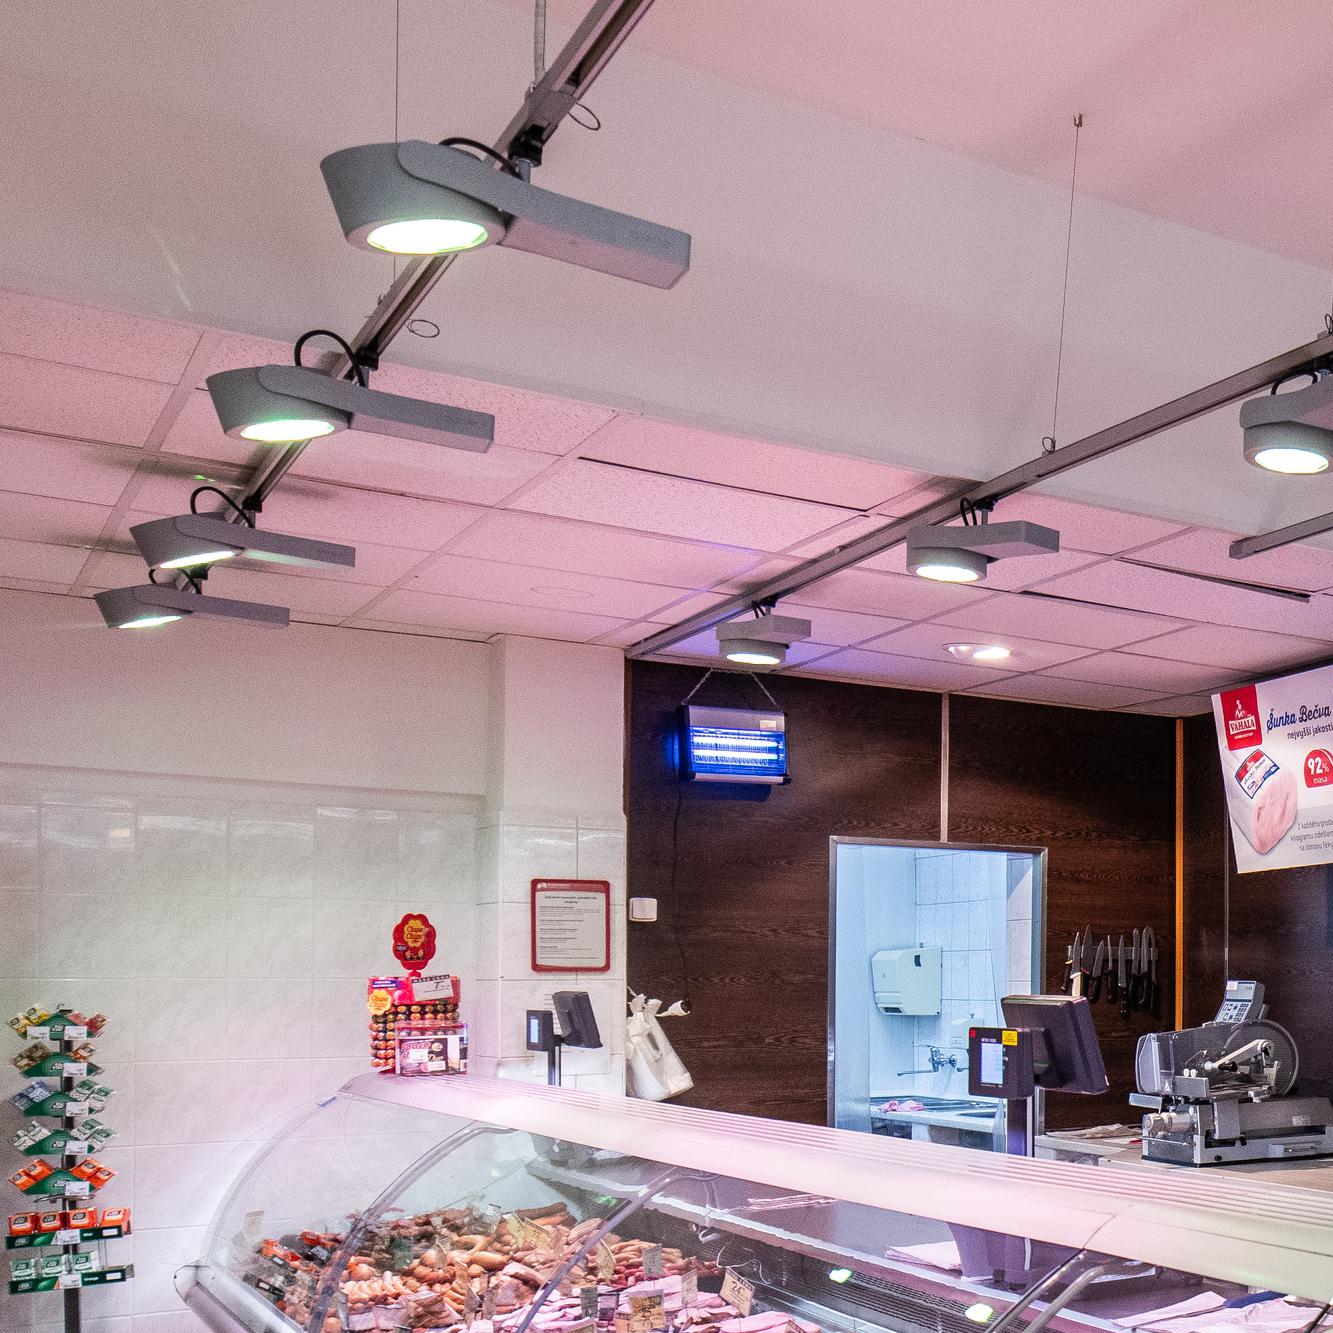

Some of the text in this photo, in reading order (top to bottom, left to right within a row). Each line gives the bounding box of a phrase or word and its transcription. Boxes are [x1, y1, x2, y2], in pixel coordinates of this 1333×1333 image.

[1230, 718, 1255, 731] VÁHALA
[1267, 704, 1332, 733] Šunka Bečva
[1287, 723, 1333, 741] nejvyšší jakosti
[1307, 757, 1330, 775] 92%
[1313, 777, 1328, 785] masa
